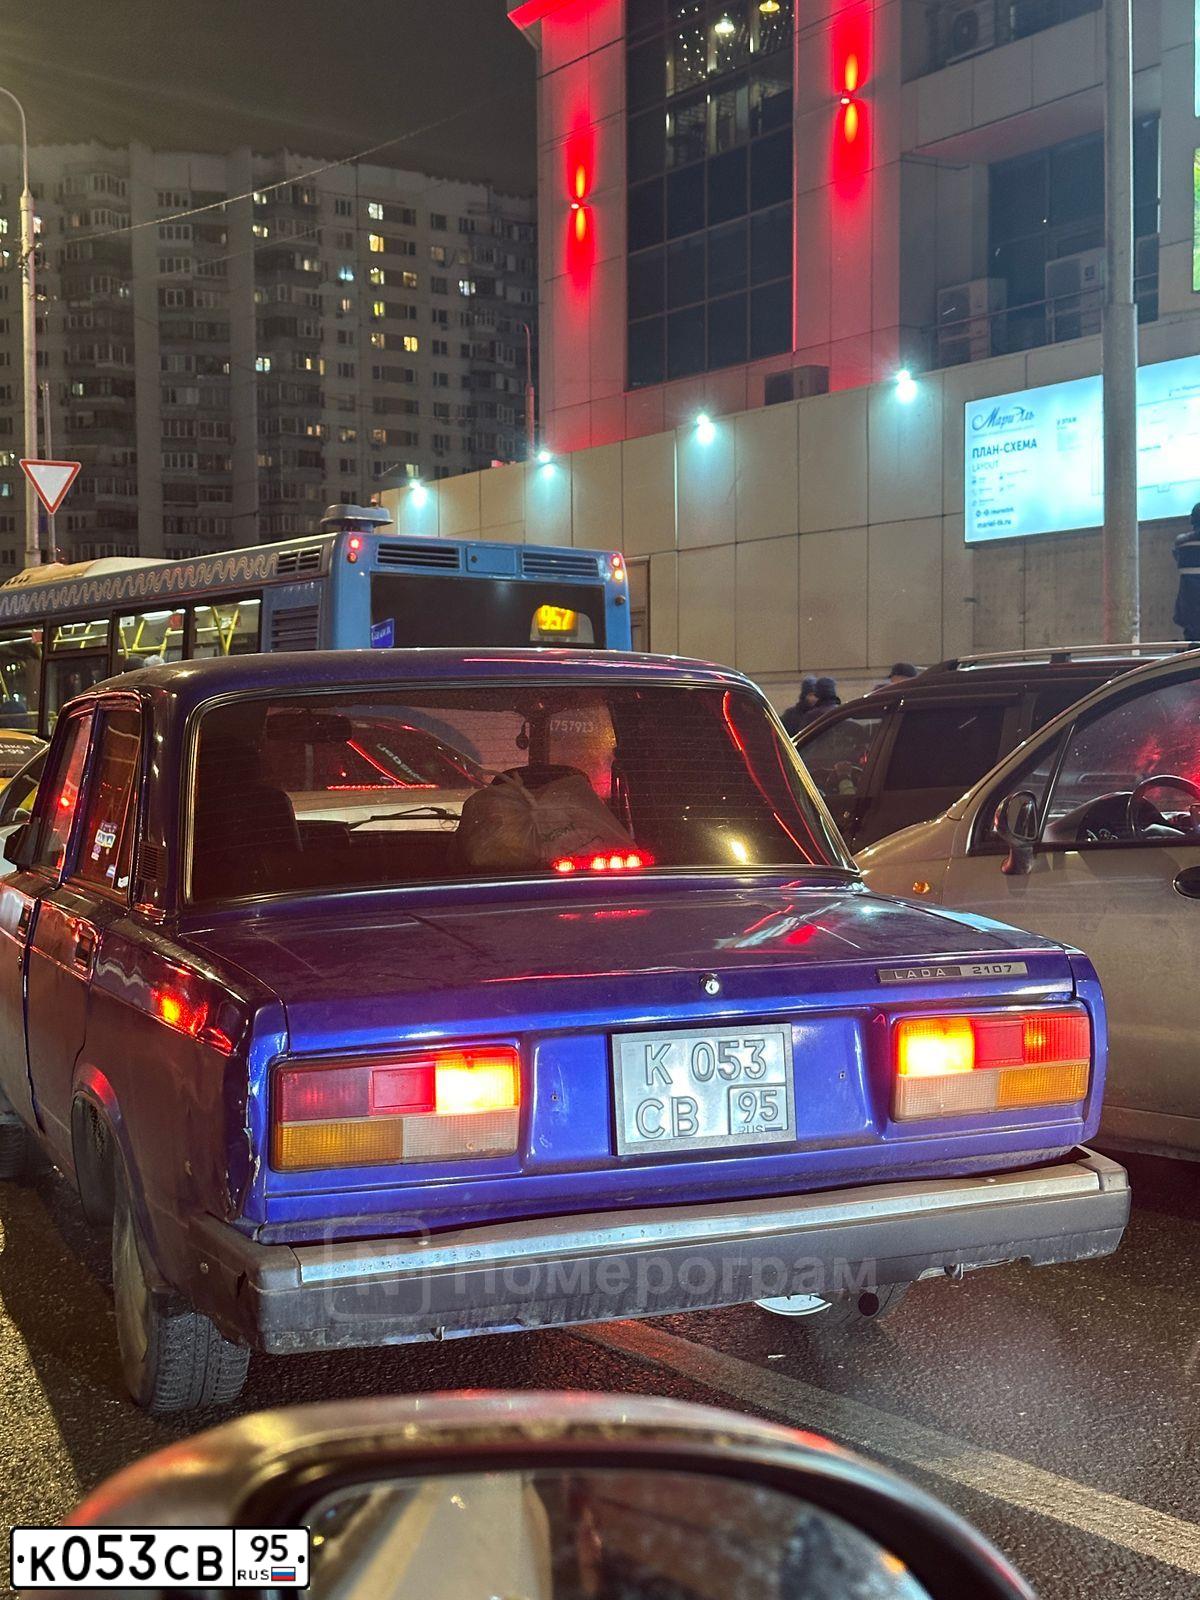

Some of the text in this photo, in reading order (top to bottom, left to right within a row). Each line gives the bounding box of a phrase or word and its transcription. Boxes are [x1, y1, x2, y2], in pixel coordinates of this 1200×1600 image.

[972, 438, 1037, 459] ПЛАН-СХЕМА
[894, 965, 1012, 979] LADA 2107
[691, 1039, 767, 1082] 053
[738, 1090, 778, 1123] 95
